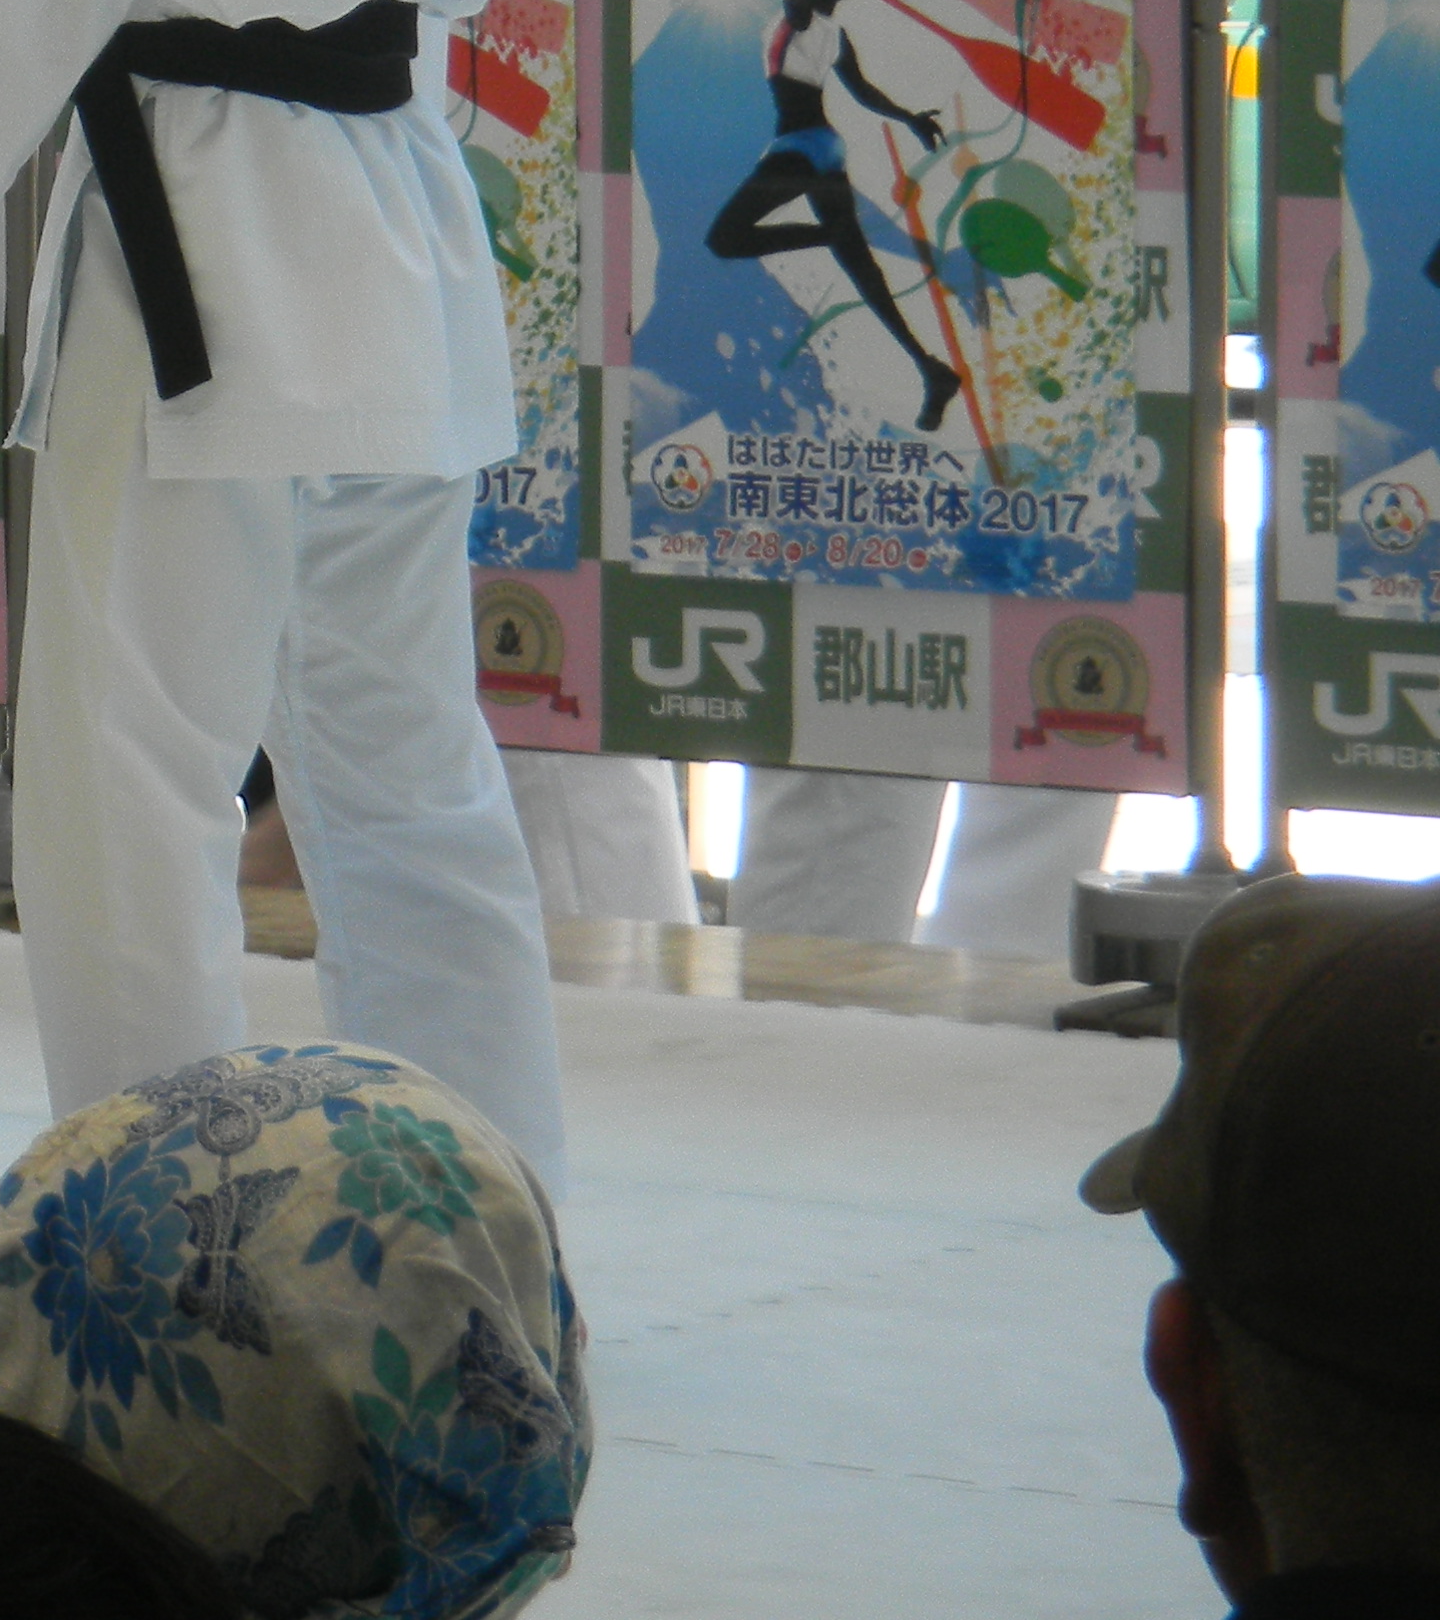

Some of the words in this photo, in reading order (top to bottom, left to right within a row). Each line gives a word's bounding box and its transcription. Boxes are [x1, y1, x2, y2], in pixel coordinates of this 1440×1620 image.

[725, 433, 966, 476] はばたけ世界へ
[726, 470, 971, 530] 南東北総体
[980, 488, 1090, 534] 2017
[631, 606, 766, 694] JR
[812, 623, 969, 712] 郡山駅
[649, 693, 750, 721] JR東日本
